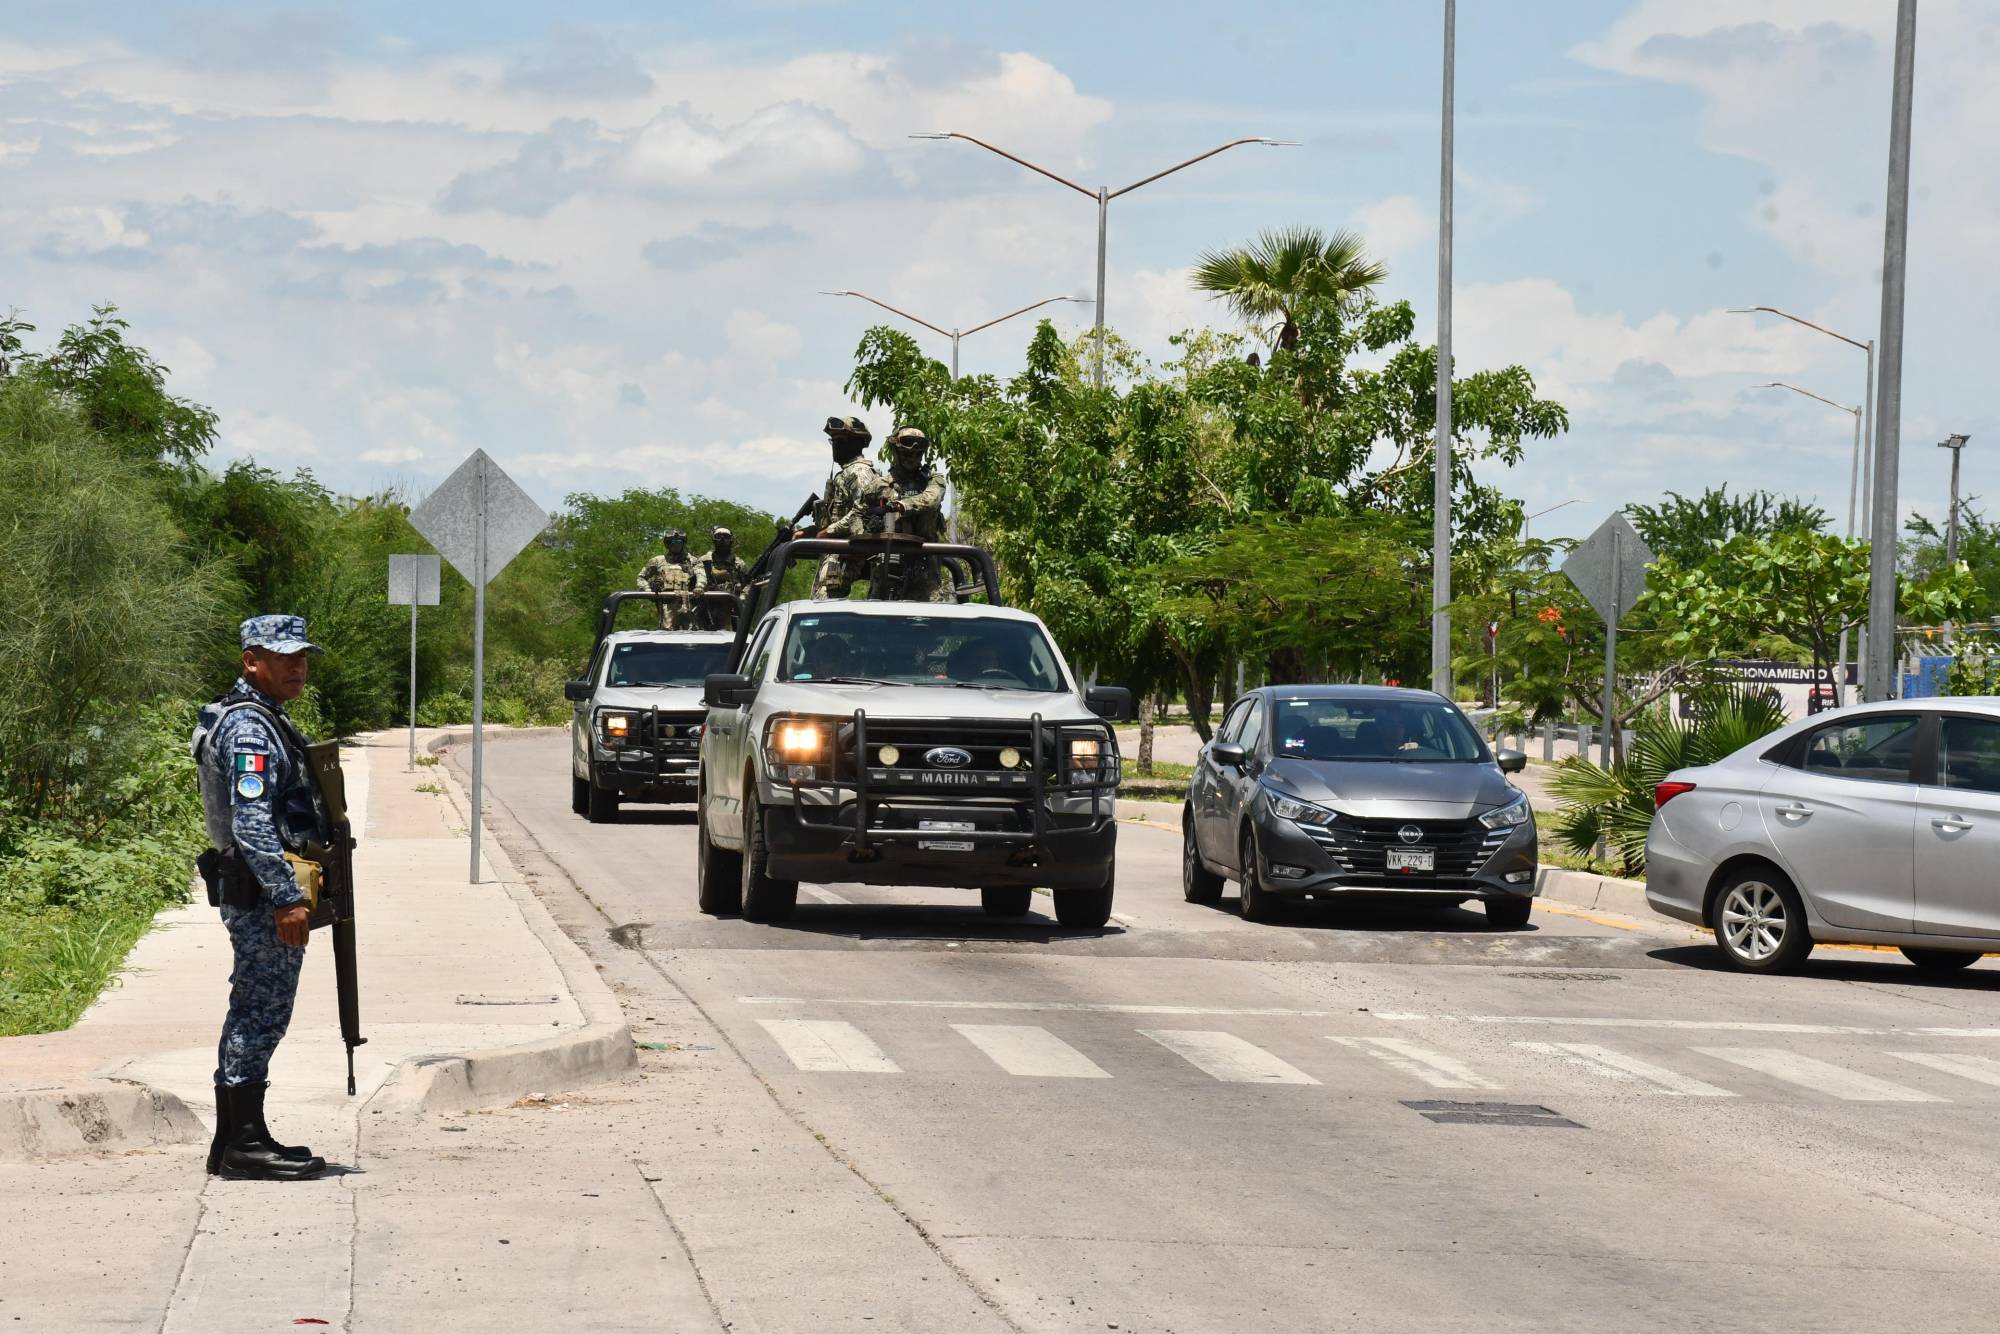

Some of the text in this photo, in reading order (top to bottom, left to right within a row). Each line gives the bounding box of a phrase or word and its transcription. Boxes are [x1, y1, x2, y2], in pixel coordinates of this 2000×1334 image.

[1706, 667, 1828, 680] ACIONAMIENTO
[936, 751, 961, 764] Ford
[921, 773, 978, 784] MARINA
